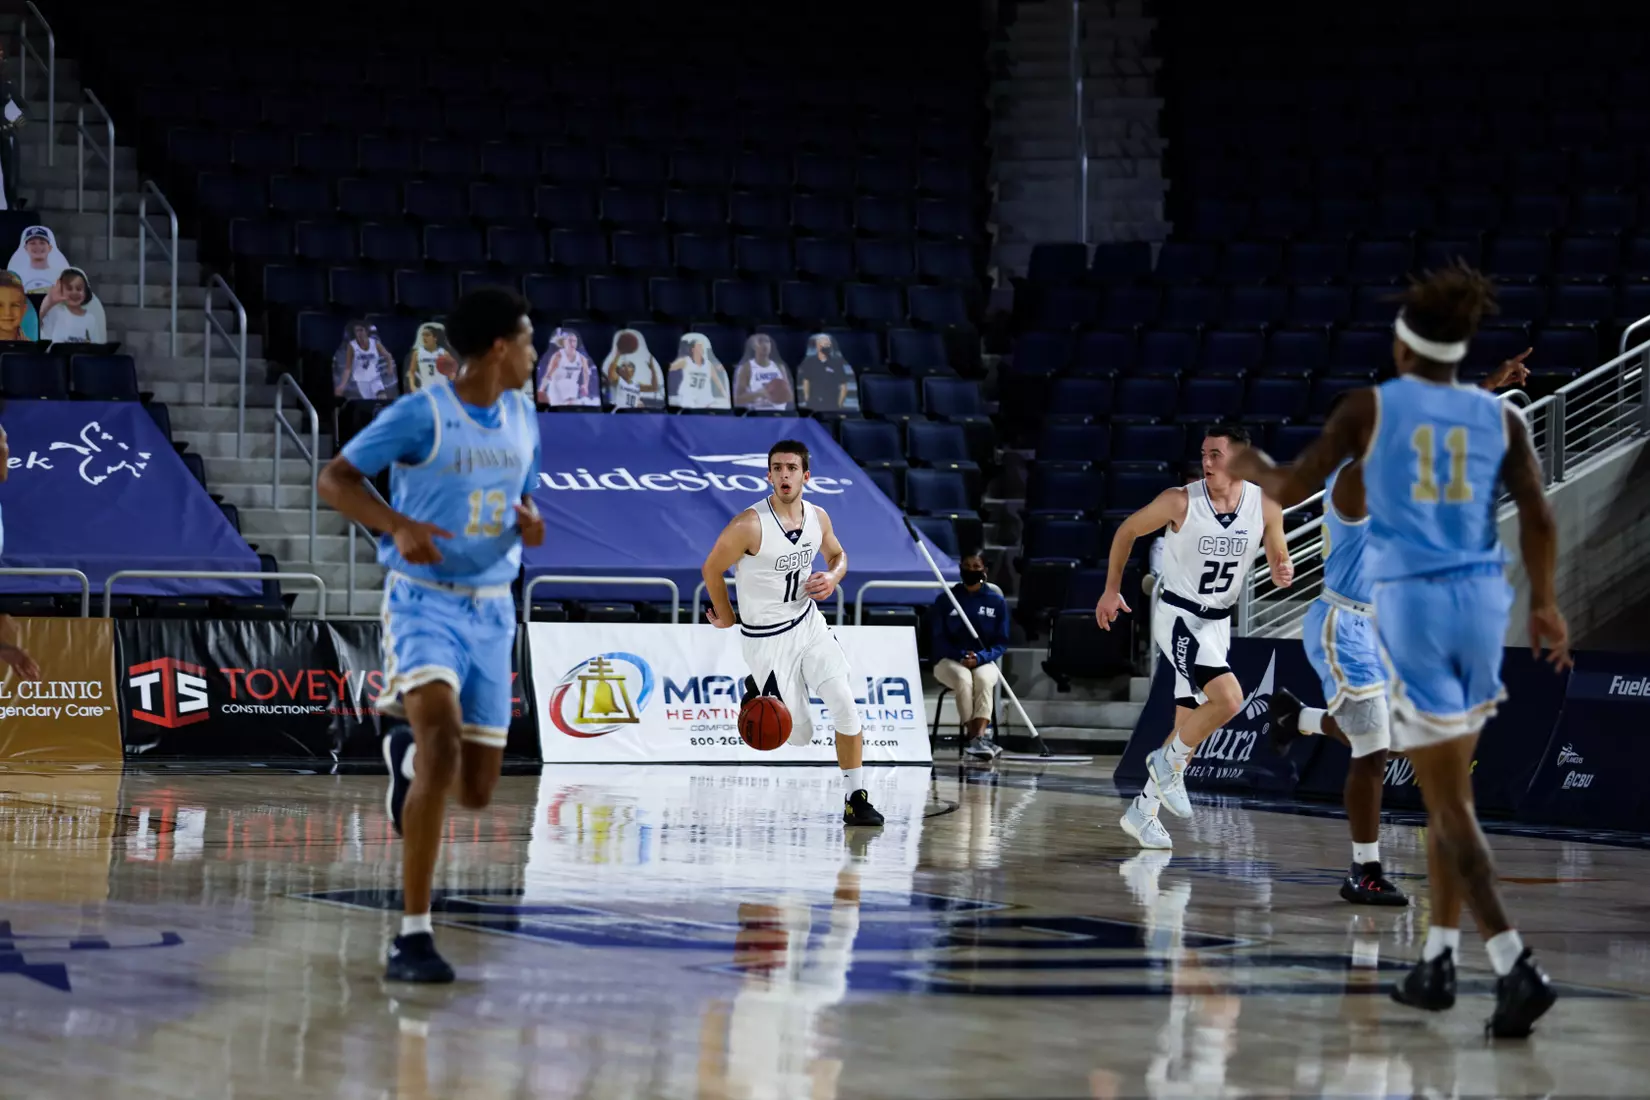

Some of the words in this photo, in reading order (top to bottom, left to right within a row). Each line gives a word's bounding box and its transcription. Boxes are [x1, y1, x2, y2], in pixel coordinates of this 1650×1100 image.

[1411, 424, 1473, 504] 11
[536, 467, 844, 495] uideStoe
[465, 488, 506, 537] 13
[1198, 536, 1248, 556] CBU
[775, 549, 812, 571] CBU
[783, 569, 801, 603] 11
[1198, 561, 1239, 594] 25
[1176, 635, 1190, 678] LANCERS
[17, 680, 103, 699] CLINIC
[221, 704, 310, 715] CONSTRUCTION
[666, 708, 741, 720] HEATIN
[690, 724, 737, 732] COMFOR
